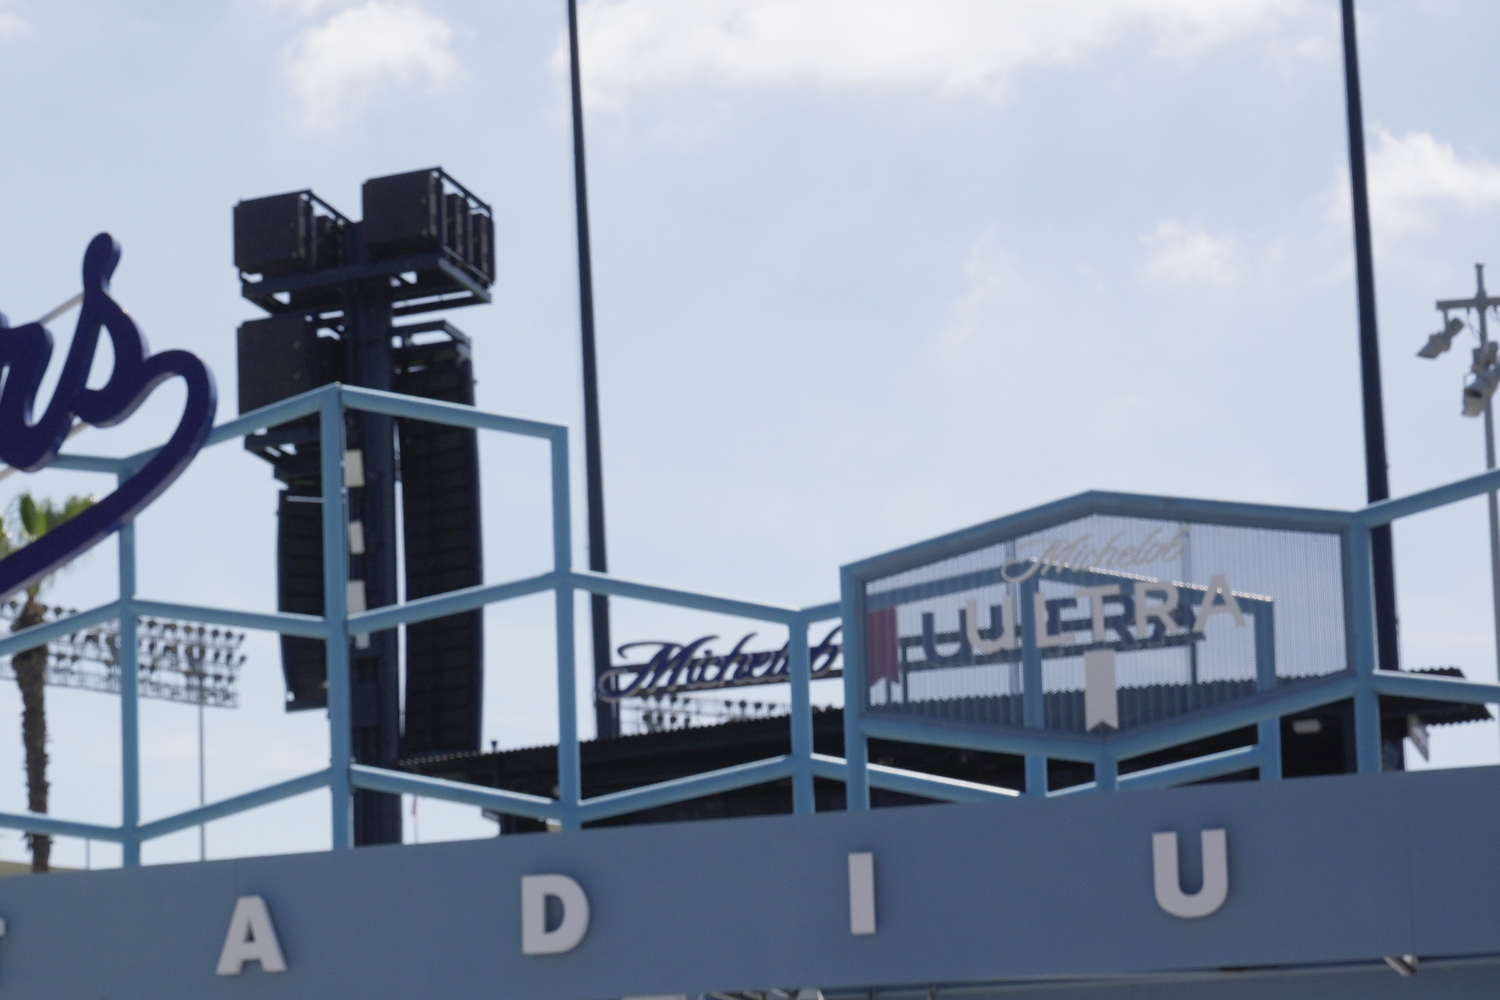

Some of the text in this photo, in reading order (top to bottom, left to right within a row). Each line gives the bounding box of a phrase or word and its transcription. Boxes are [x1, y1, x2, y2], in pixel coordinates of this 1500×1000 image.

[1002, 524, 1188, 583] Michelob
[965, 573, 1246, 652] ULTRA
[598, 625, 842, 703] Michelb
